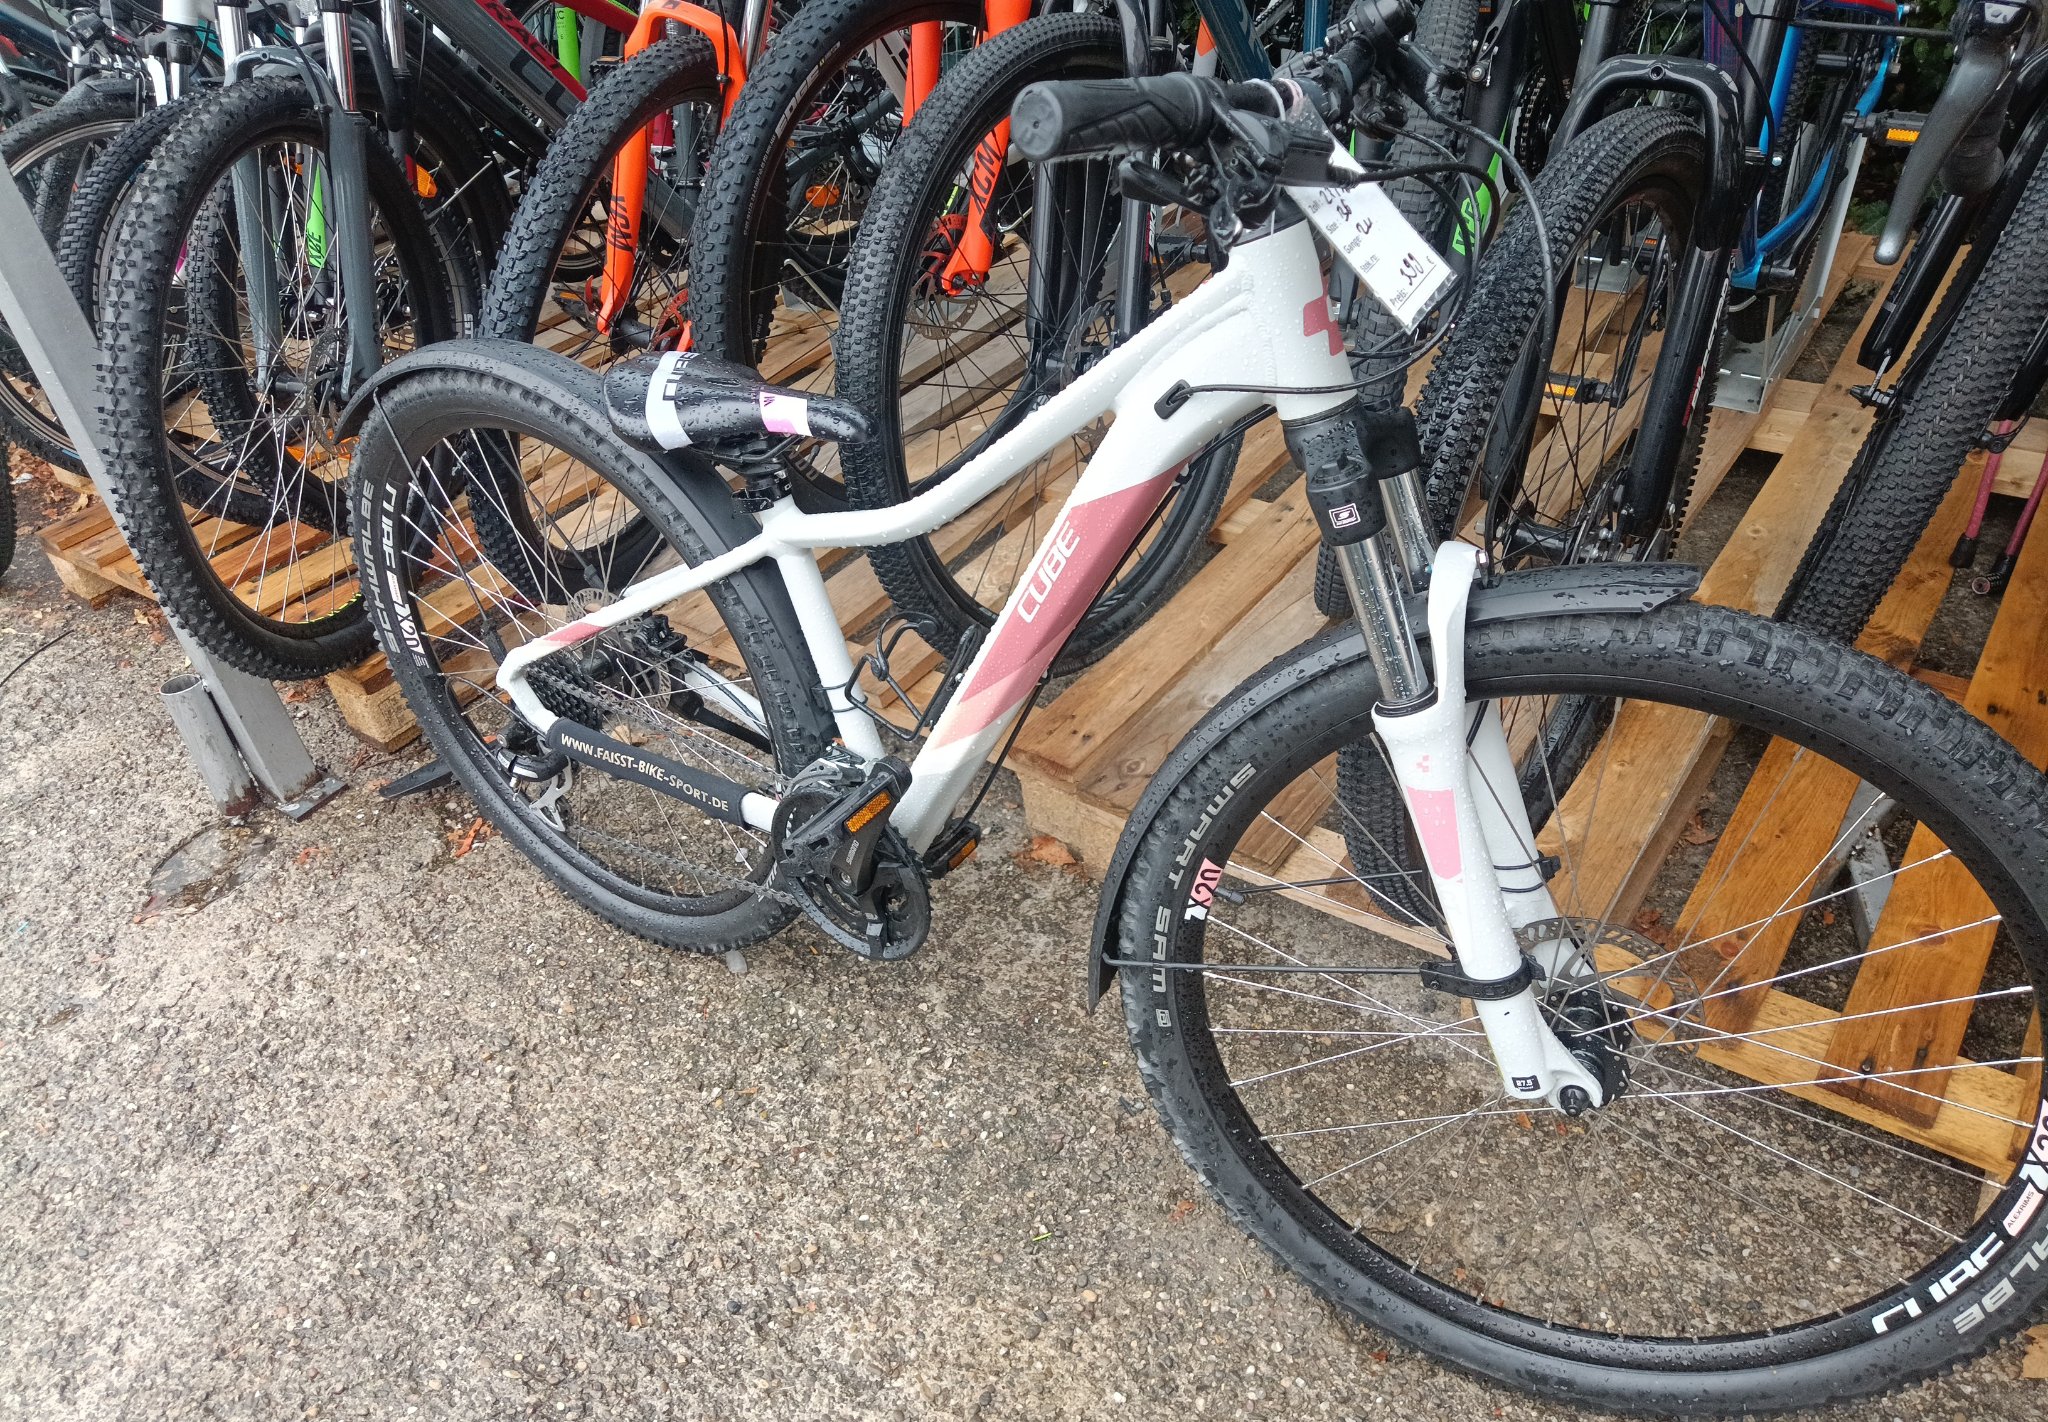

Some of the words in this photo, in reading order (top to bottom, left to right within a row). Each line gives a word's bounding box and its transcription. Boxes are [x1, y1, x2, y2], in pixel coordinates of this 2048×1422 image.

[361, 479, 401, 654] SCHWALBE
[1017, 520, 1081, 624] CUBE
[561, 733, 729, 812] WWW.FAISST-BIKE-SPORT.DE
[1168, 762, 1257, 890] SMART
[1152, 905, 1172, 993] SAM
[2007, 1190, 2034, 1228] ALEXRIMS
